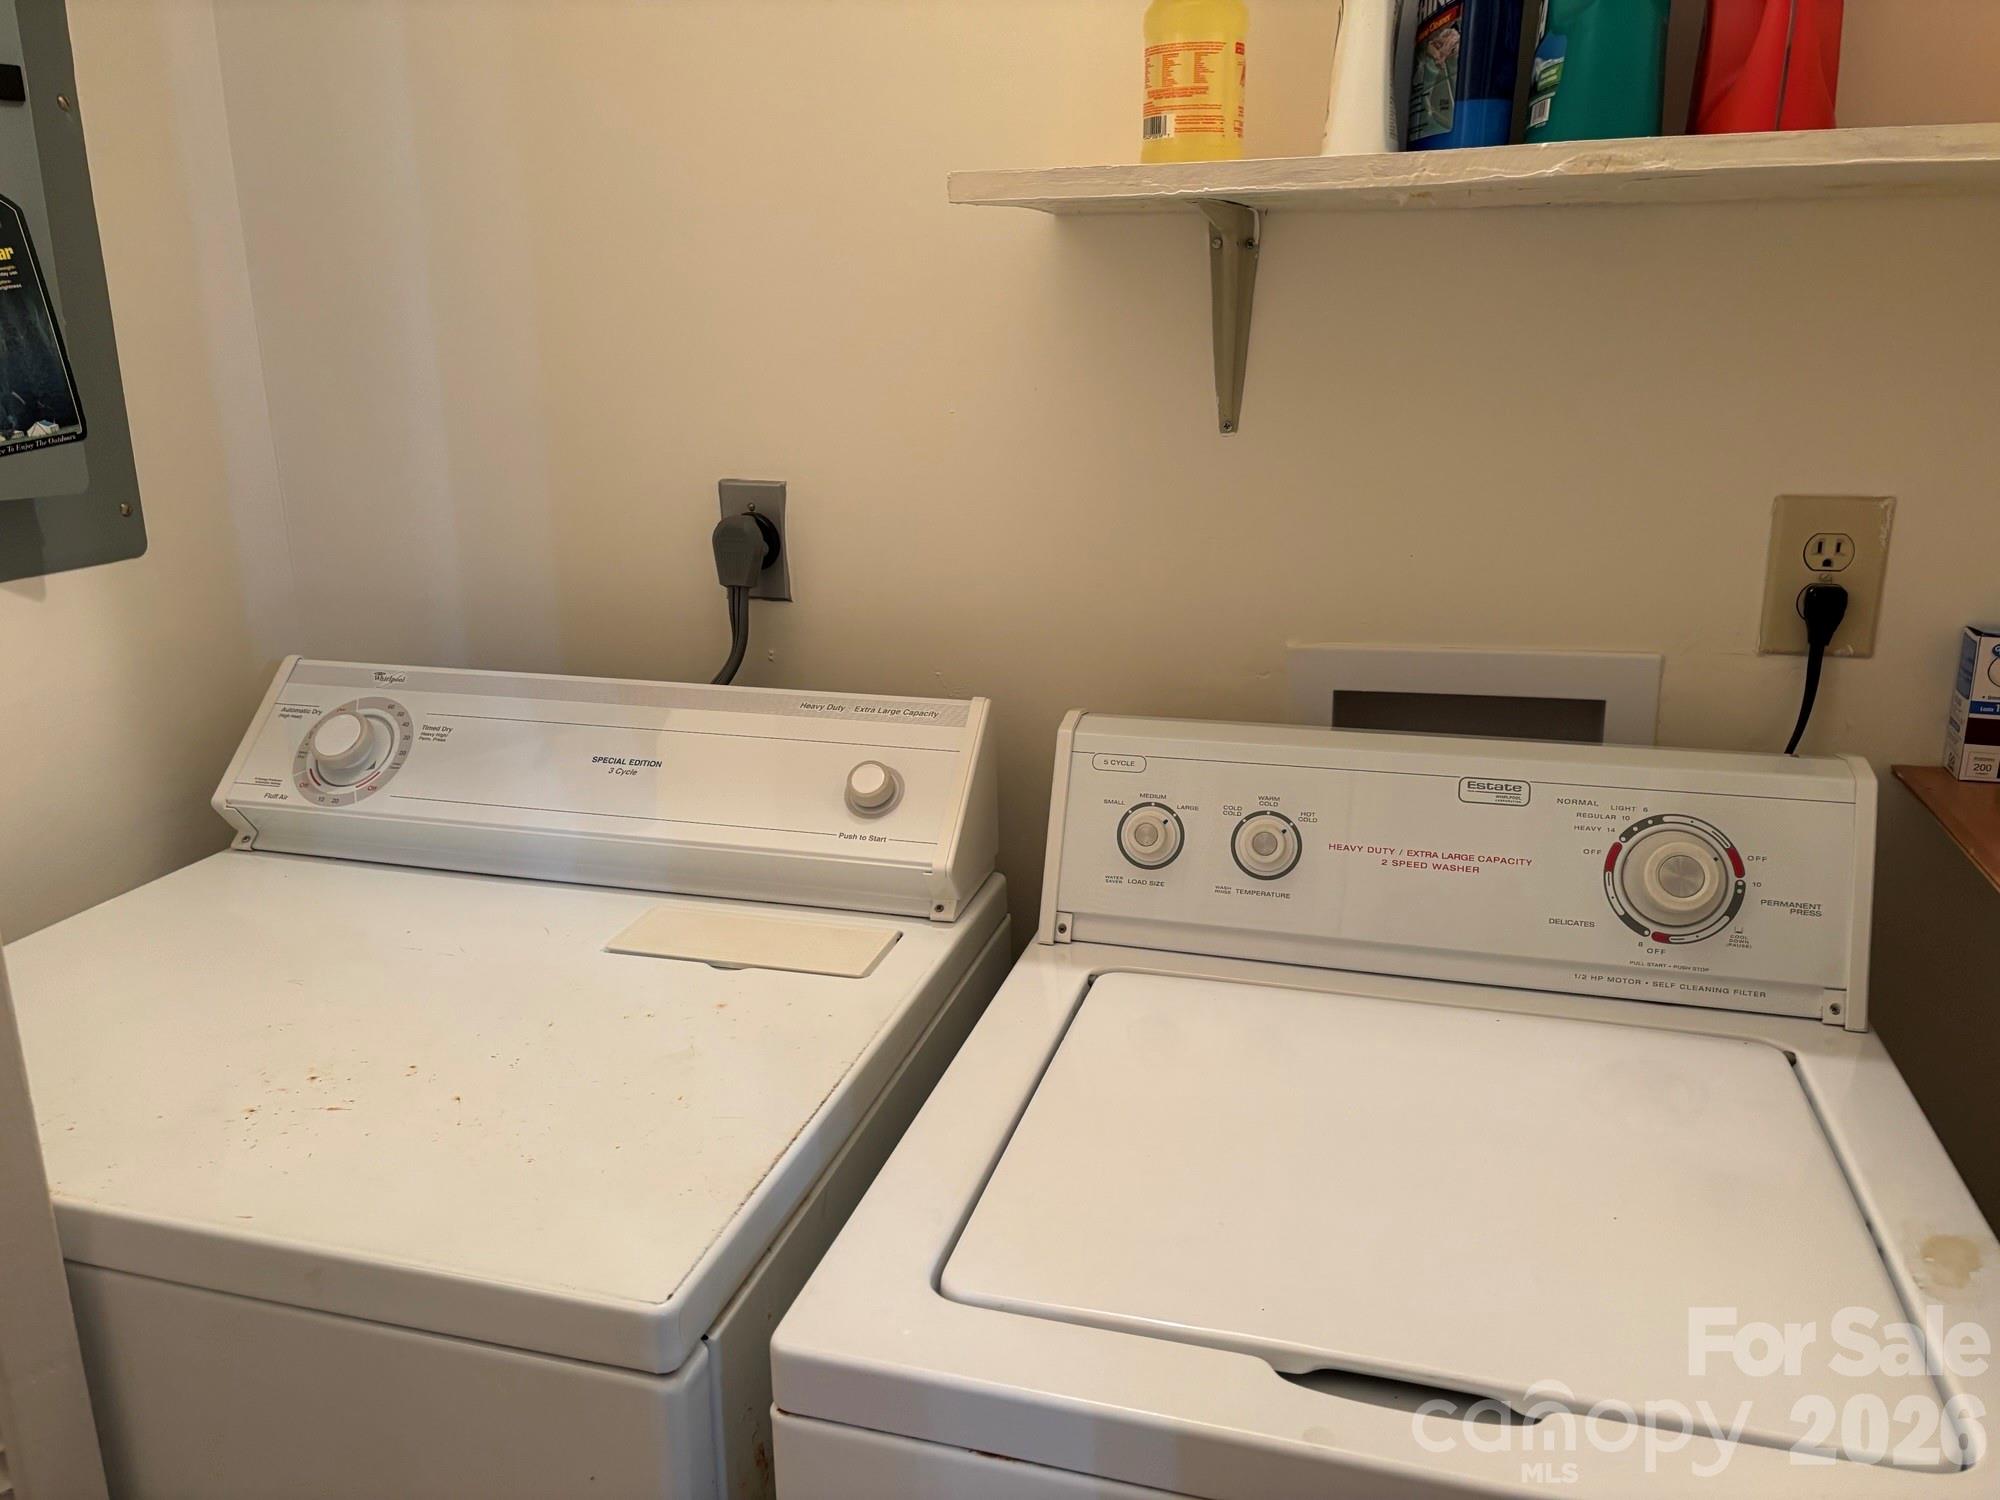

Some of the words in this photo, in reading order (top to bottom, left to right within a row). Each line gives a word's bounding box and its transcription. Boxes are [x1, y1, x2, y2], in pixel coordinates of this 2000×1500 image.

[16, 444, 34, 452] Enjoy
[48, 435, 76, 444] Outdoors
[374, 674, 406, 684] Whirlpool
[312, 708, 323, 716] Dry
[800, 702, 825, 711] Heavy
[827, 703, 846, 712] Duty
[902, 709, 940, 718] Capacity
[592, 756, 626, 765] SPECIAL
[628, 759, 662, 768] EDITION
[615, 768, 638, 776] Cycle
[1973, 763, 1992, 772] 200
[1466, 780, 1522, 792] Estate
[1557, 798, 1599, 807] NORMAL
[1576, 812, 1616, 820] REGULAR
[1328, 843, 1364, 852] HEAVY
[1367, 846, 1396, 856] DUTY
[1406, 849, 1439, 860] EXTRA
[1442, 852, 1475, 862] LARGE
[1478, 855, 1533, 866] CAPACITY
[1392, 860, 1428, 870] SPEED
[1432, 862, 1480, 874] WASHER
[1236, 888, 1291, 899] TEMPERATURE
[1760, 900, 1822, 910] PERMANENT
[1790, 908, 1822, 917] PRESS
[1548, 918, 1595, 928] DELICATES
[1607, 976, 1642, 985] MOTOR
[1680, 984, 1730, 994] CLEANING
[1733, 989, 1766, 998] FILTER
